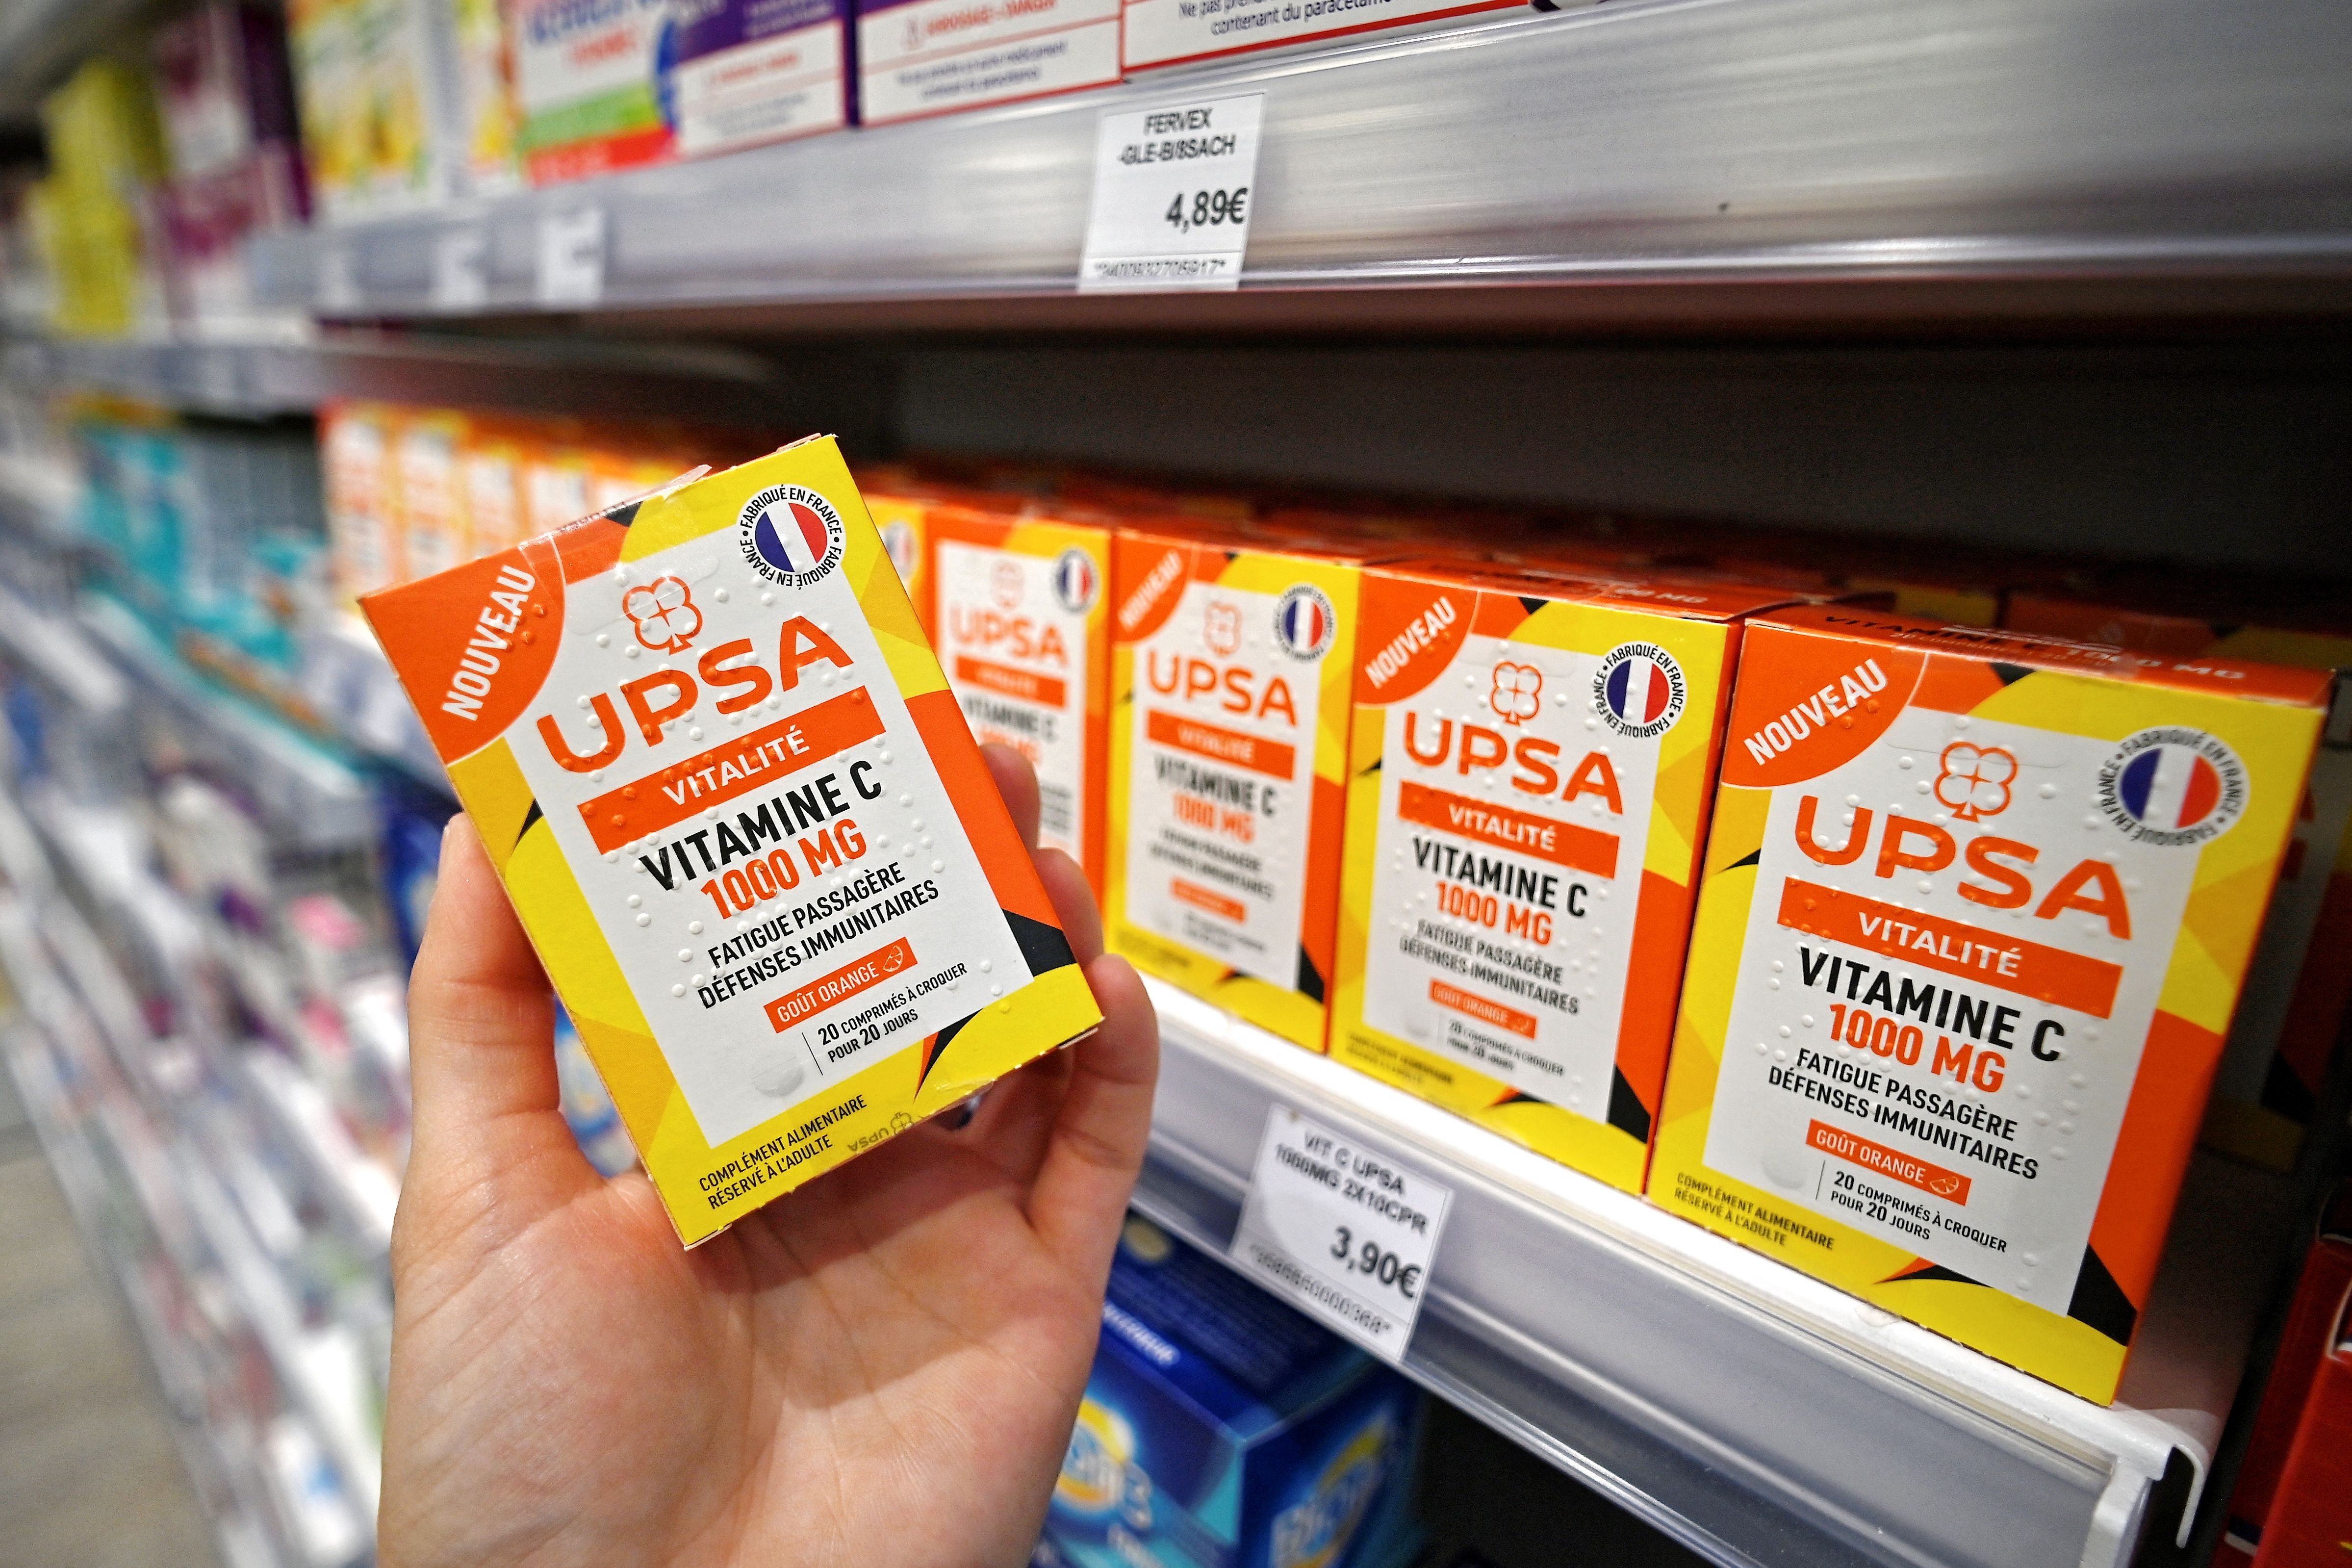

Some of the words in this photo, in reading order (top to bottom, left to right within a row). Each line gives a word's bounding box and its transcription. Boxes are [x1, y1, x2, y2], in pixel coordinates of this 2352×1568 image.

[1211, 7, 1280, 35] contenant
[1282, 2, 1301, 21] du
[1143, 108, 1213, 135] FERVEX
[1165, 187, 1248, 234] 4,89€
[741, 484, 787, 528] FABRIQUÉ
[790, 488, 806, 502] EN
[806, 493, 842, 535] FRANCE
[740, 539, 776, 581] FRANCE
[776, 572, 793, 587] EN
[795, 545, 842, 590] FABRIQUÉ
[441, 565, 537, 721] NOUVEAU
[949, 606, 1069, 666] UPSA
[1364, 595, 1457, 689] NOUVEAU
[537, 615, 854, 773] UPSA
[1147, 650, 1298, 728] UPSA
[1594, 671, 1609, 715] FRANCE
[1605, 645, 1659, 667] FABRIQUÉ
[1656, 652, 1672, 669] EN
[1666, 666, 1684, 712] FRANCE
[1743, 658, 1888, 766] NOUVEAU
[1604, 713, 1619, 729] EN
[1617, 717, 1670, 738] FABRIQUÉ
[662, 725, 810, 805] VITALITÉ
[1154, 753, 1254, 811] VITAMINE
[1261, 786, 1277, 816] C
[1403, 711, 1624, 815] UPSA
[639, 773, 850, 891] VITAMINE
[850, 761, 882, 800] C
[1448, 803, 1556, 852] VITALITÉ
[701, 848, 800, 920] 1000
[798, 819, 867, 877] MG
[1413, 836, 1558, 909] VITAMINE
[1567, 883, 1587, 918] C
[1794, 795, 2131, 940] UPSA
[697, 946, 801, 1009] DÉFENSES
[801, 879, 939, 959] IMMUNITAIRES
[708, 915, 793, 969] FATIGUE
[792, 862, 905, 929] PASSAGÈRE
[1436, 881, 1498, 928] 1000
[1505, 902, 1553, 946] MG
[1859, 912, 2022, 978] VITALITÉ
[1400, 935, 1467, 974] DÉFENSES
[1470, 962, 1580, 1015] IMMUNITAIRES
[1417, 919, 1475, 954] FATIGUE
[1476, 940, 1563, 985] PASSAGÈRE
[776, 990, 818, 1024] GOÛT
[819, 962, 881, 1006] ORANGE
[818, 1023, 840, 1045] 20
[841, 991, 907, 1034] COMPRIMÉS
[908, 986, 917, 1000] À
[915, 962, 968, 996] CROQUER
[1800, 946, 2021, 1050] VITAMINE
[2031, 1018, 2065, 1062] C
[828, 1038, 861, 1063] POUR
[859, 1023, 881, 1046] 20
[883, 1009, 919, 1035] JOURS
[1829, 1003, 1923, 1066] 1000
[1931, 1035, 2006, 1093] MG
[1768, 1065, 1869, 1118] DÉFENSES
[1873, 1104, 2039, 1180] IMMUNITAIRES
[1796, 1048, 1882, 1094] FATIGUE
[1885, 1079, 2018, 1142] PASSAGÈRE
[699, 1136, 786, 1191] COMPLÉMENT
[788, 1094, 868, 1146] ALIMENTAIRE
[708, 1168, 767, 1209] RÉSERVÉ
[767, 1161, 778, 1180] À
[779, 1134, 834, 1173] L'ADULTE
[847, 1128, 890, 1152] UPSA
[1305, 1131, 1334, 1157] VIT
[1335, 1148, 1352, 1167] C
[1353, 1156, 1406, 1195] UPSA
[1816, 1128, 1858, 1160] GOÛT
[1859, 1146, 1925, 1183] ORANGE
[1276, 1143, 1340, 1188] 1000MG
[1343, 1178, 1429, 1235] 2X10CPR
[1674, 1187, 1723, 1217] RÉSERVÉ
[1724, 1208, 1733, 1223] À
[1734, 1213, 1786, 1246] L'ADULTE
[1677, 1172, 1754, 1215] COMPLÉMENT
[1755, 1205, 1835, 1250] ALIMENTAIRE
[1831, 1190, 1864, 1213] POUR
[1866, 1202, 1887, 1223] 20
[1889, 1214, 1930, 1240] JOURS
[1834, 1170, 1854, 1191] 20
[1857, 1184, 1931, 1222] COMPRIMÉS
[1932, 1209, 1942, 1228] À
[1944, 1218, 2007, 1253] CROQUER
[1329, 1225, 1422, 1299] 3,90€
